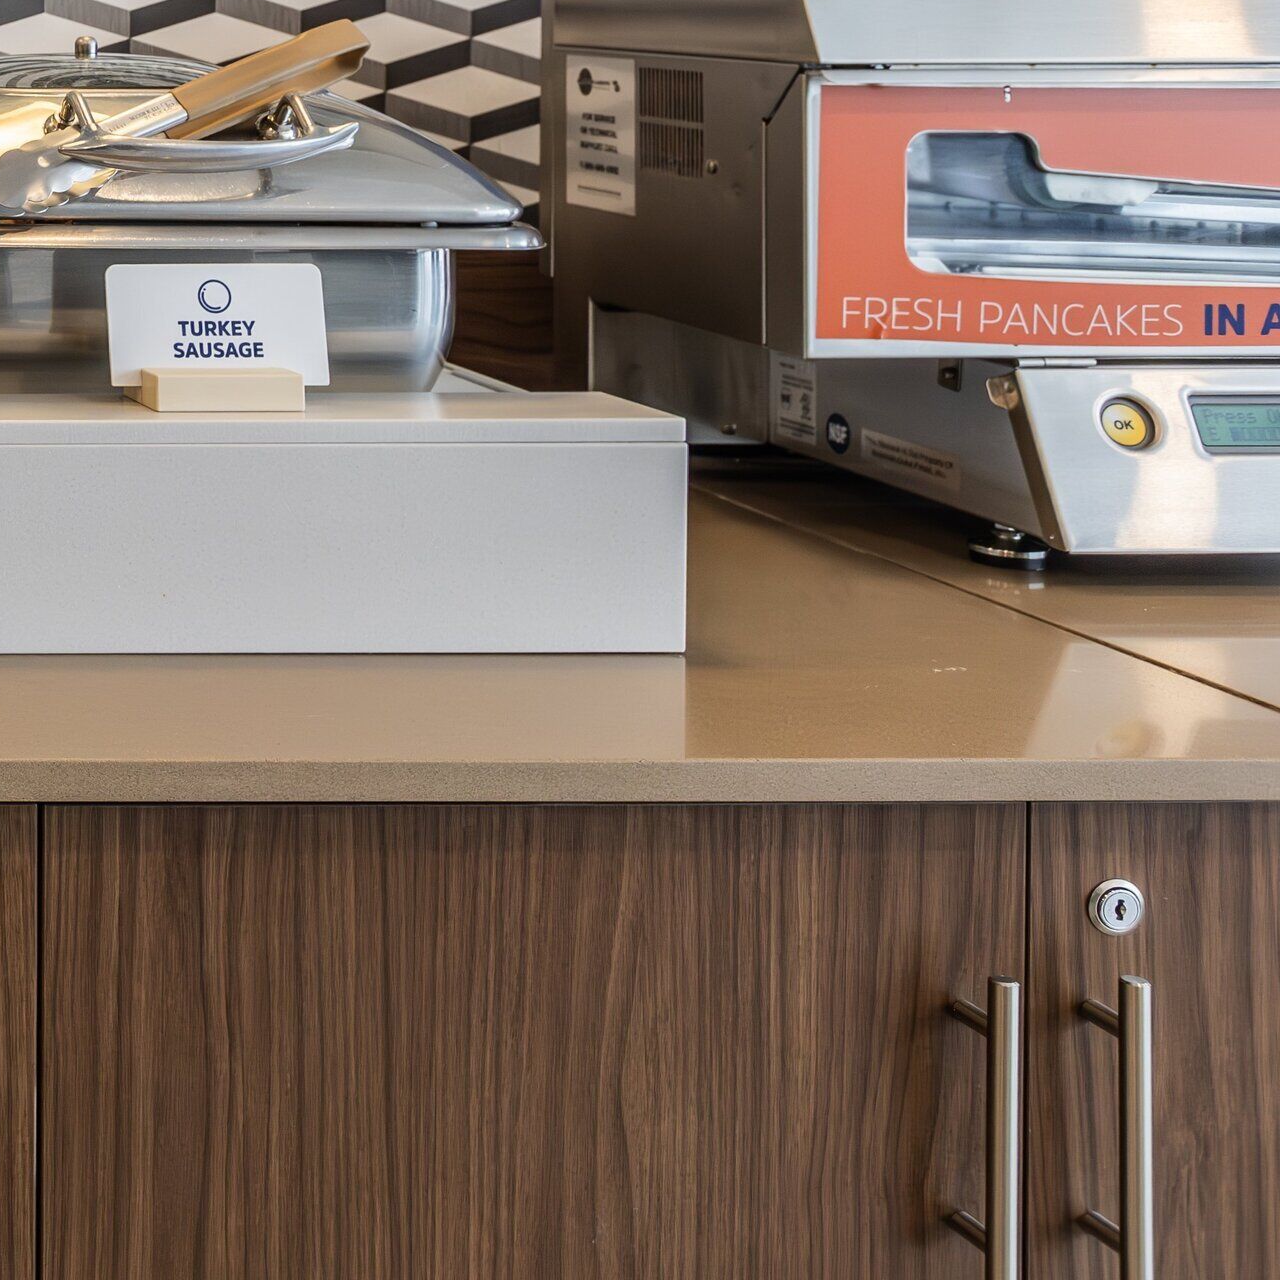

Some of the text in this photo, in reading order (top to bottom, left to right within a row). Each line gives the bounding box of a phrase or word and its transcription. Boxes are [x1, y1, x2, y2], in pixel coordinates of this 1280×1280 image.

[842, 296, 961, 333] FRESH
[979, 301, 1184, 336] PANCAKES
[1203, 303, 1245, 336] IN
[177, 320, 255, 336] TURKEY
[173, 342, 264, 358] SAUSAGE
[1114, 419, 1134, 430] OK
